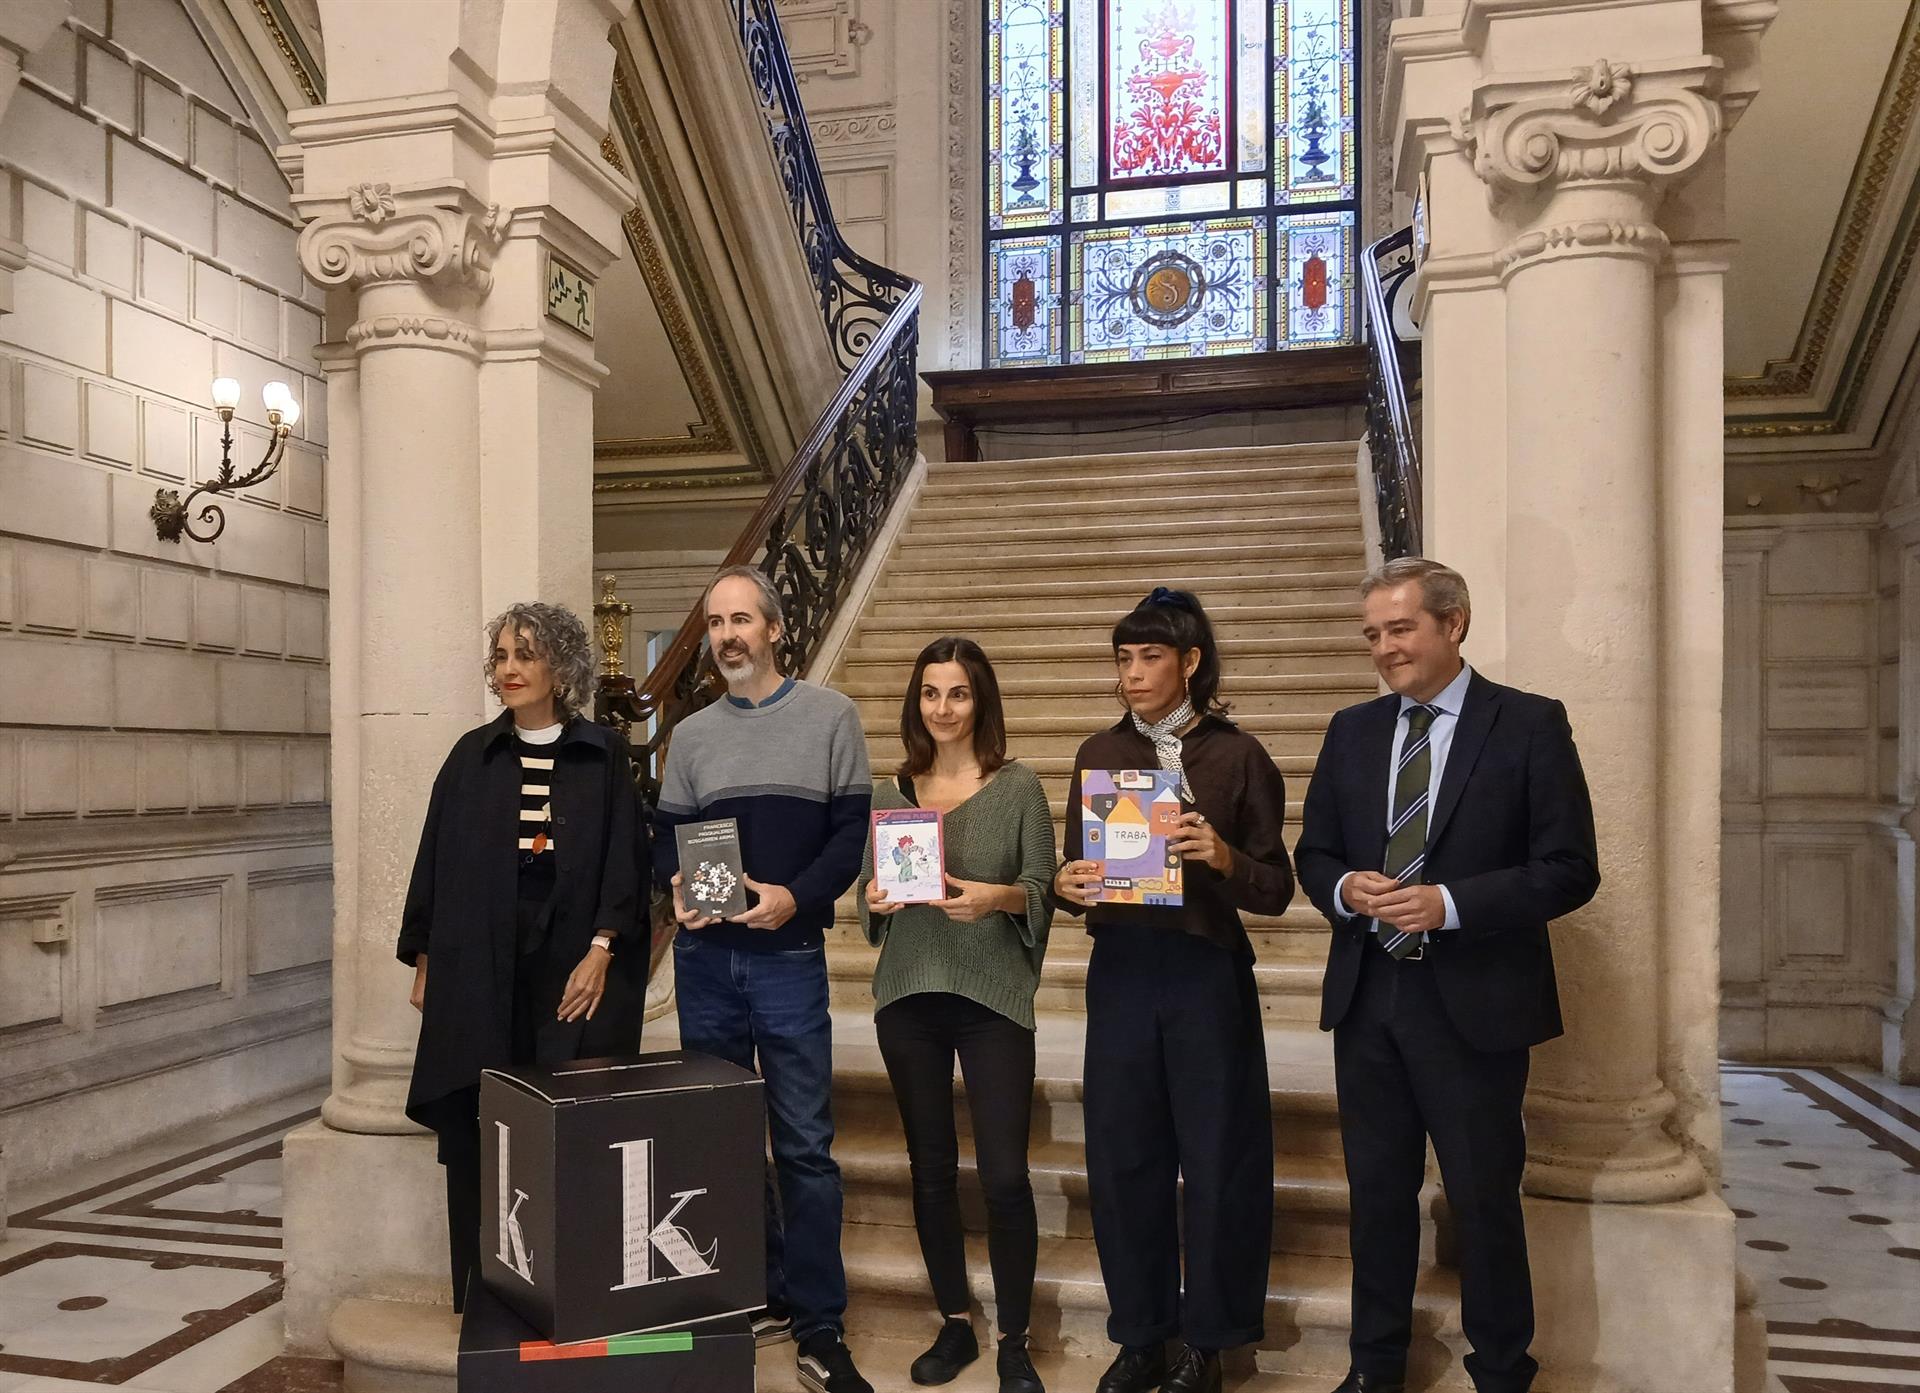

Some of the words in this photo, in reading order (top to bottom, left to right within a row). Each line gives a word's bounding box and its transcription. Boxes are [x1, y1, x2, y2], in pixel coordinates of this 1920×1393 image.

[703, 822, 734, 830] FRANCESCO
[1114, 831, 1148, 839] TRABA
[494, 1120, 534, 1286] k
[609, 1138, 720, 1291] k
